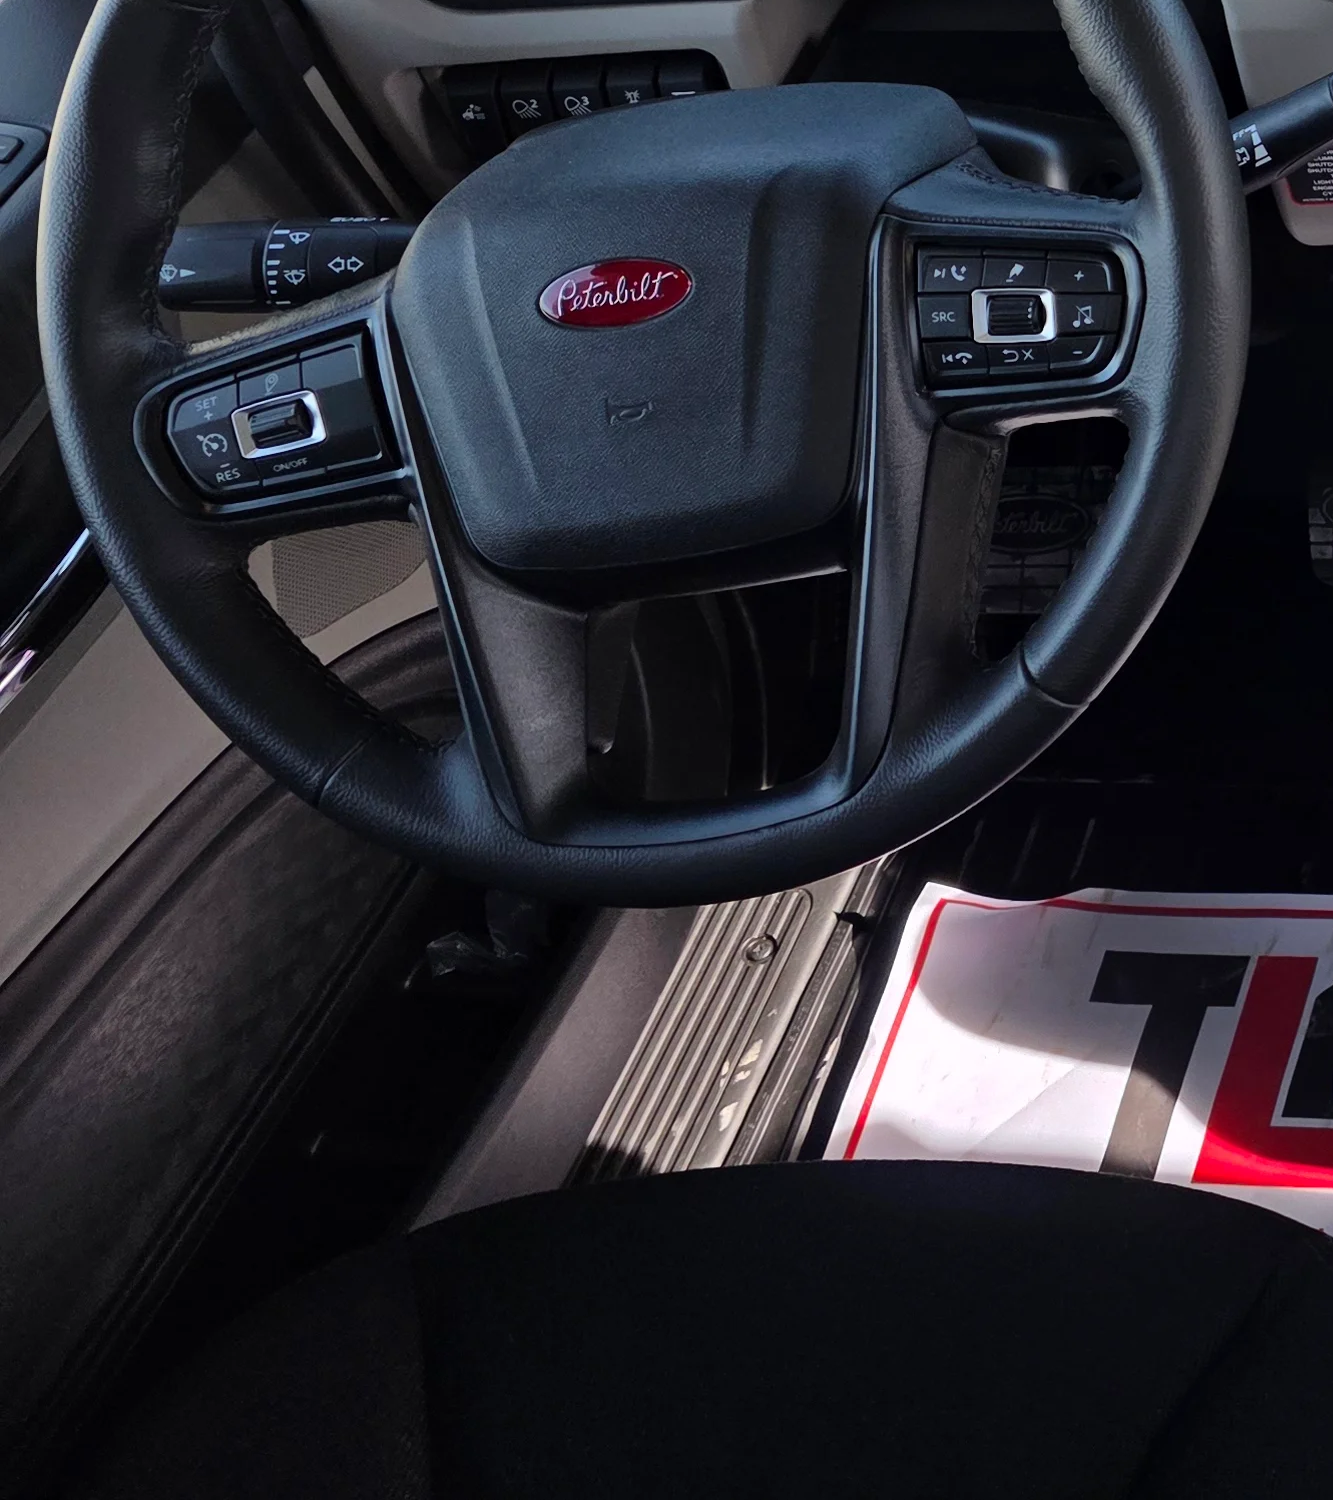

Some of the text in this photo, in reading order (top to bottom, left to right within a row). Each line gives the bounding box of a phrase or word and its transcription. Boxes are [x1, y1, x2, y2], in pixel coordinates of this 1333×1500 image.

[557, 271, 679, 317] Peterbilt
[931, 311, 956, 323] SRC
[195, 396, 218, 412] SET
[273, 457, 308, 472] ON/OFF
[215, 468, 241, 483] RES
